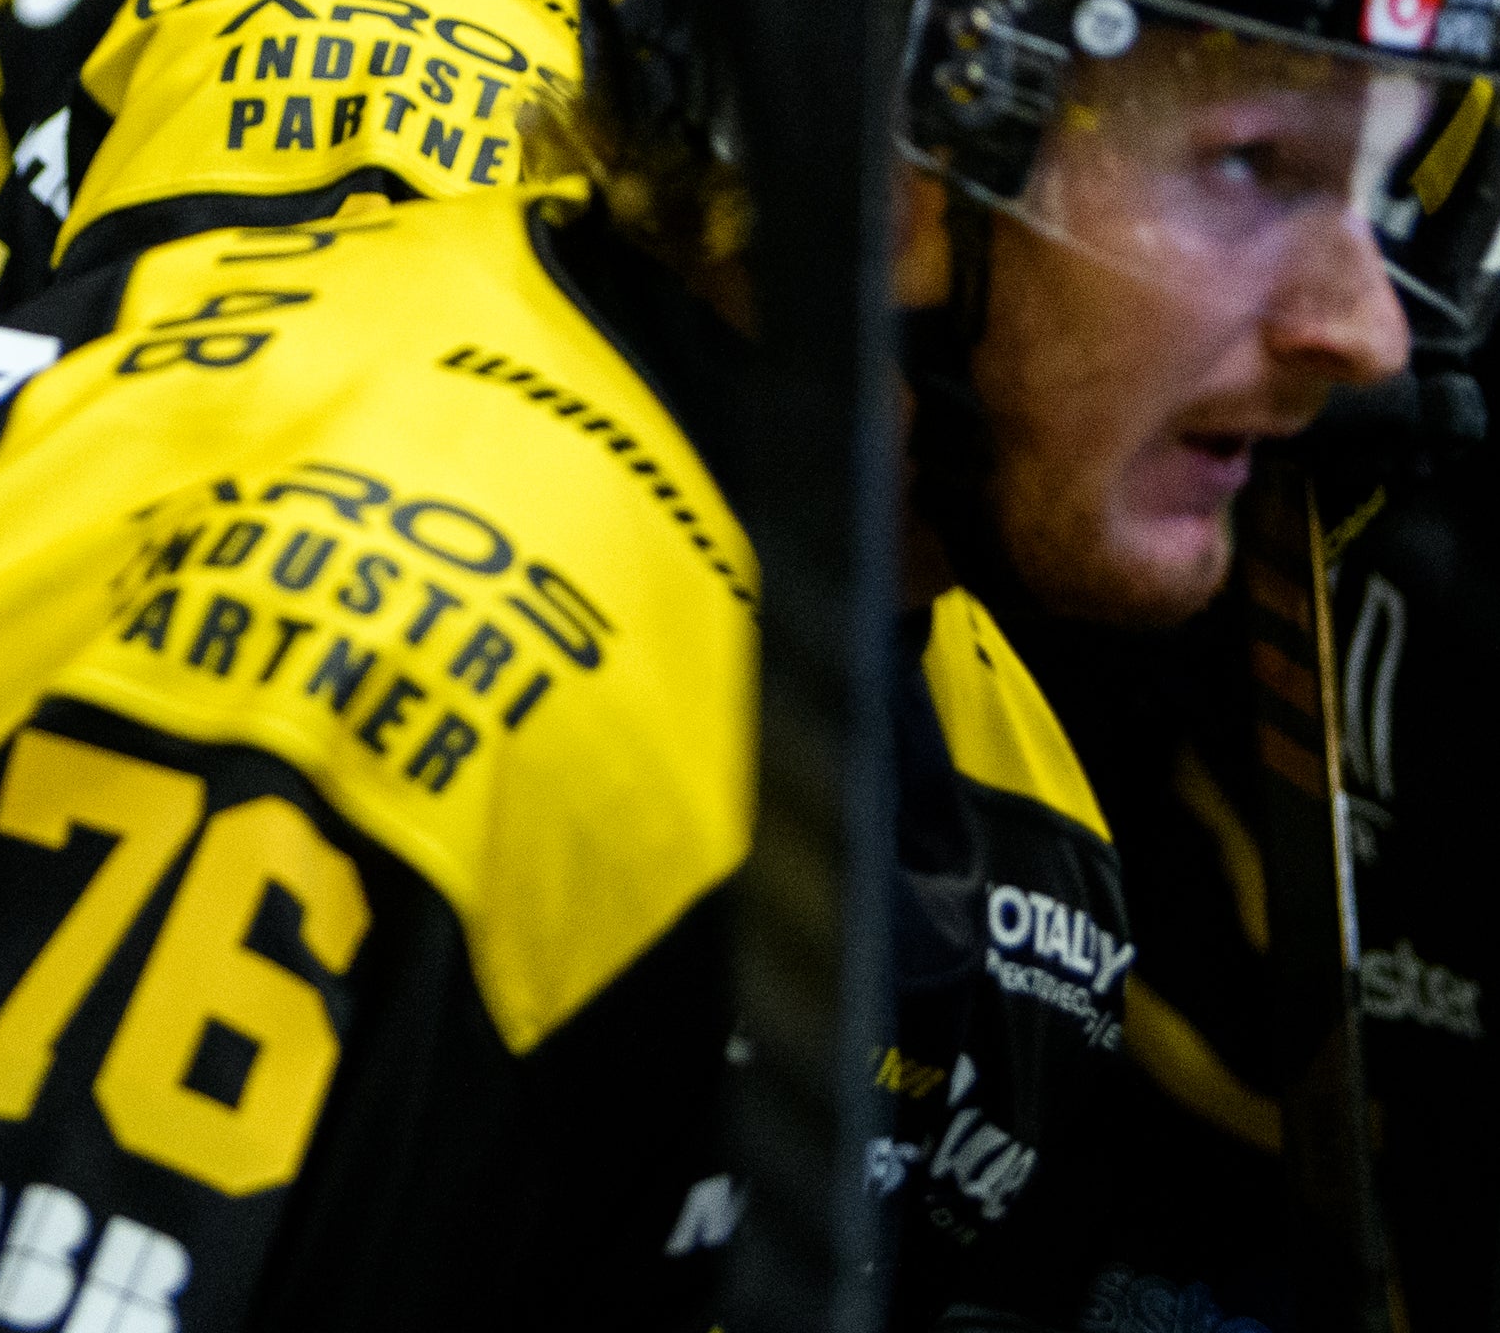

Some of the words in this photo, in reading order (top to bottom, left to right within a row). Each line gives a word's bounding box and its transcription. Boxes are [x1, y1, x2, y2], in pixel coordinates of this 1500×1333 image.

[221, 33, 512, 121] INDUST
[227, 90, 510, 187] PARTNE
[112, 585, 482, 796] ARTNER
